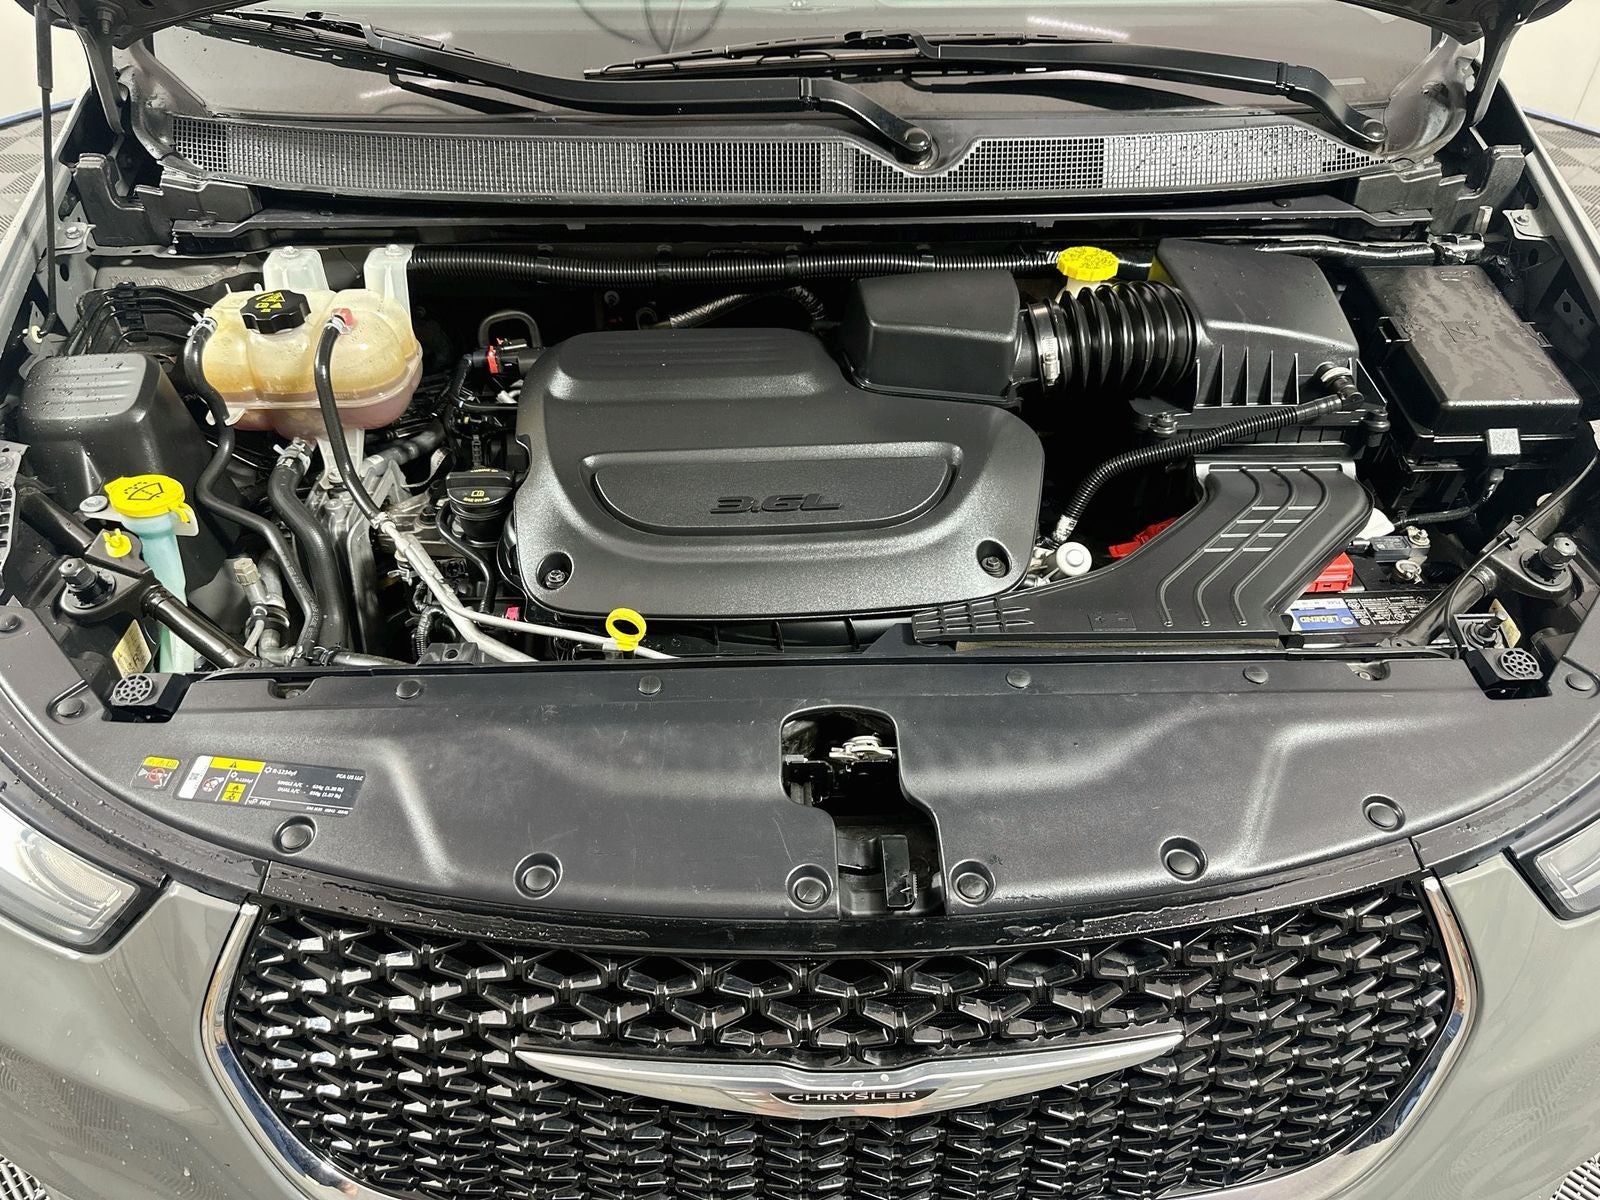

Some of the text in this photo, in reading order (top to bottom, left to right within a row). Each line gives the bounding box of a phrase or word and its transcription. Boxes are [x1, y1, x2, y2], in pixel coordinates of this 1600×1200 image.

[710, 493, 842, 514] 3.6L
[1299, 614, 1339, 623] LEGEND
[788, 1091, 917, 1102] CHRYSLER
